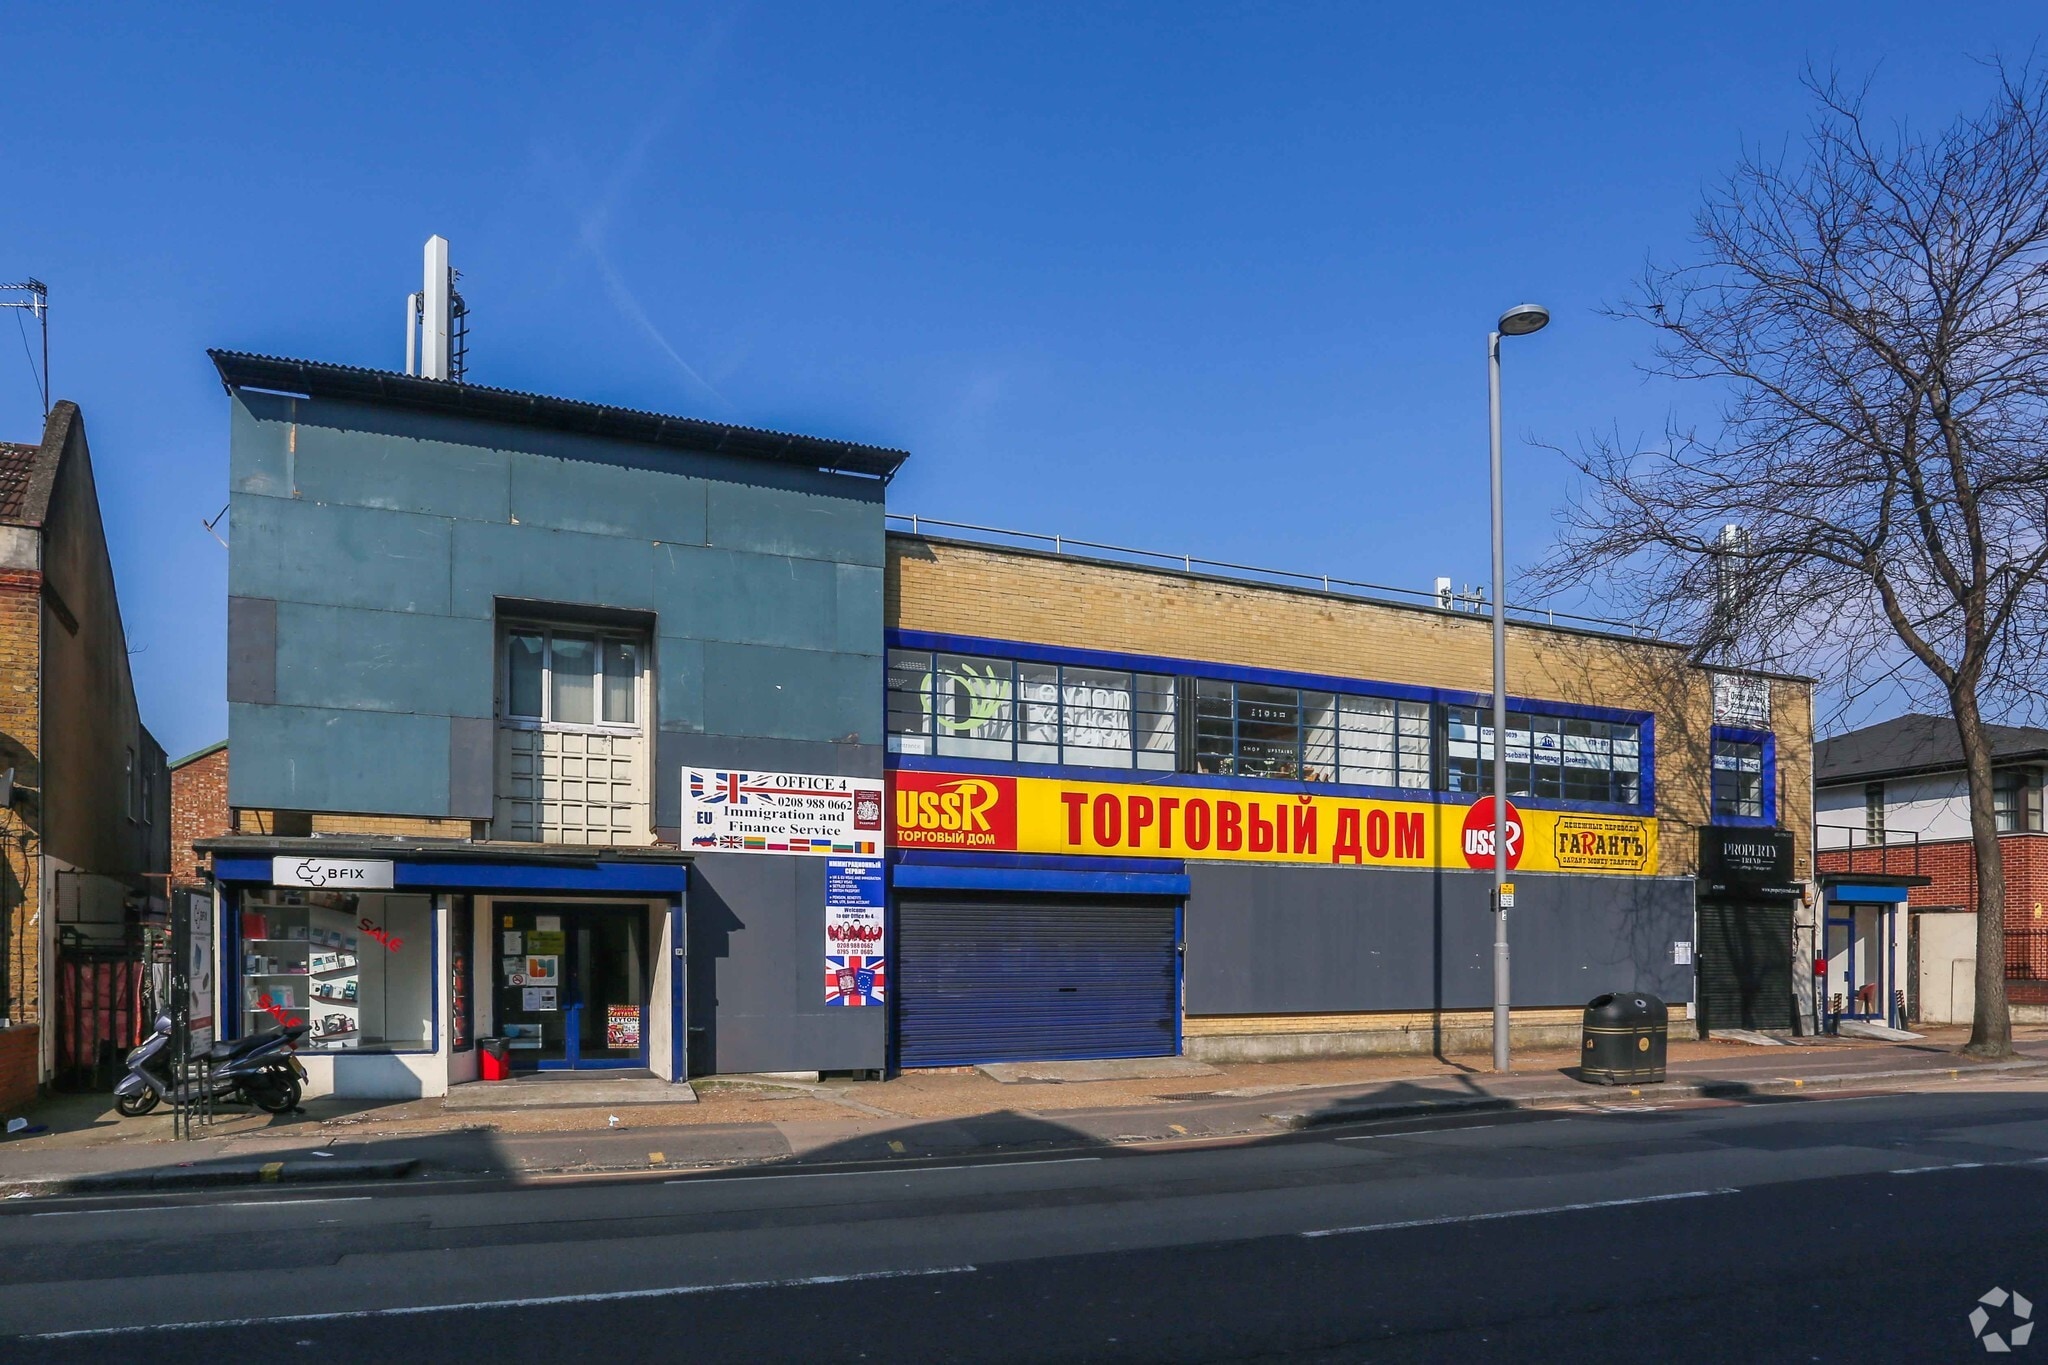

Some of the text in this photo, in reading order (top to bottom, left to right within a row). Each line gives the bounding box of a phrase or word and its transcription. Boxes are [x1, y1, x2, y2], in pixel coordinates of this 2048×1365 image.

[1504, 751, 1587, 764] osebank Mortgage Brokers
[776, 775, 835, 791] OFFICE
[838, 779, 847, 791] 4
[778, 797, 853, 811] 0208 988 0662
[897, 779, 999, 832] USSR
[697, 811, 713, 825] EU
[724, 806, 845, 822] Immigration and
[729, 820, 841, 836] Finance Service
[1061, 791, 1425, 864] ТОРГОВЫЙ ДОМ
[1564, 821, 1640, 833] ДЕНЕЖНЫЕ ПЕРЕВОДЫ
[897, 830, 996, 846] ТОРГОВЫЙ ДОМ
[1723, 842, 1777, 858] PROPERTY
[1587, 857, 1608, 866] MONEY
[328, 868, 365, 879] BFIX
[357, 917, 404, 954] SALE
[255, 993, 304, 1029] SALE
